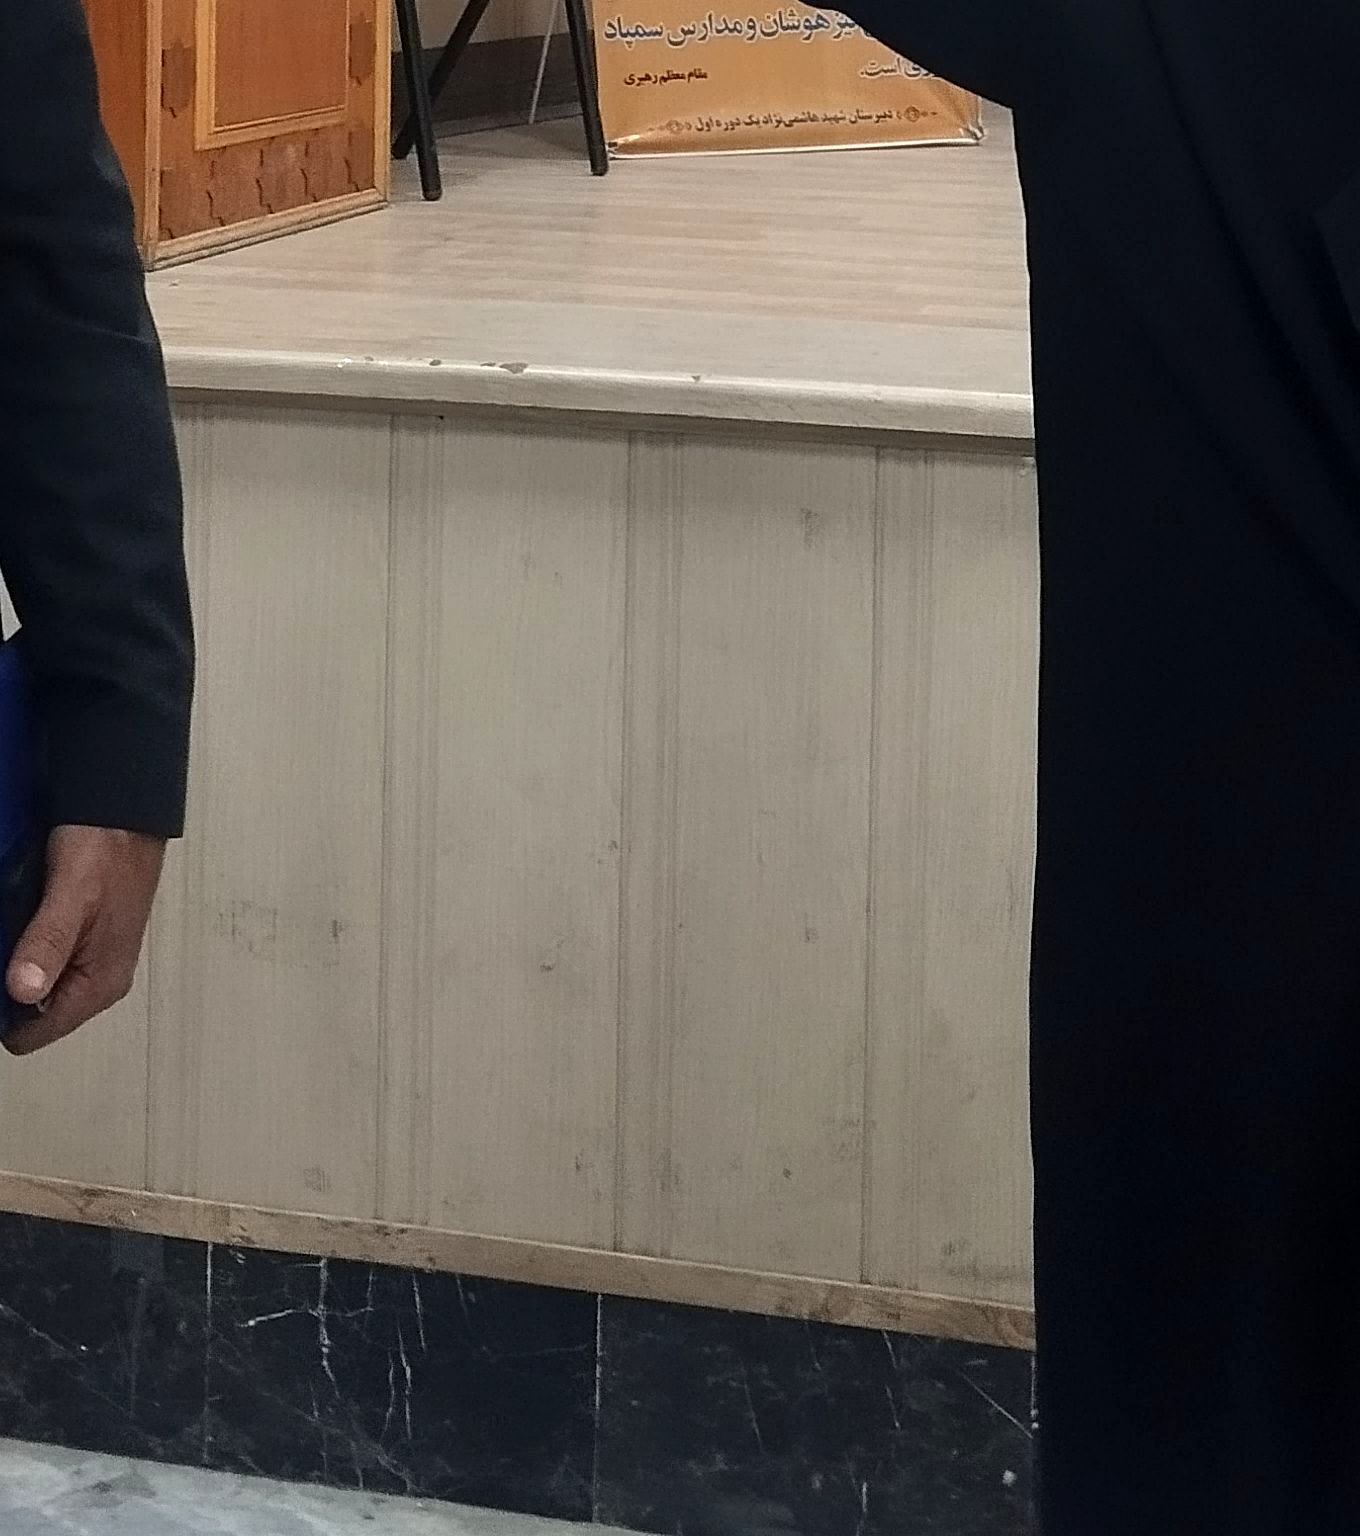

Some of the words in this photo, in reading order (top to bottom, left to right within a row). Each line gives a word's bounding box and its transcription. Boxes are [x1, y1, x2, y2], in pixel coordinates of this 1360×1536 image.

[604, 16, 664, 49] سمپاد
[667, 14, 744, 47] مدارس
[745, 17, 757, 41] و
